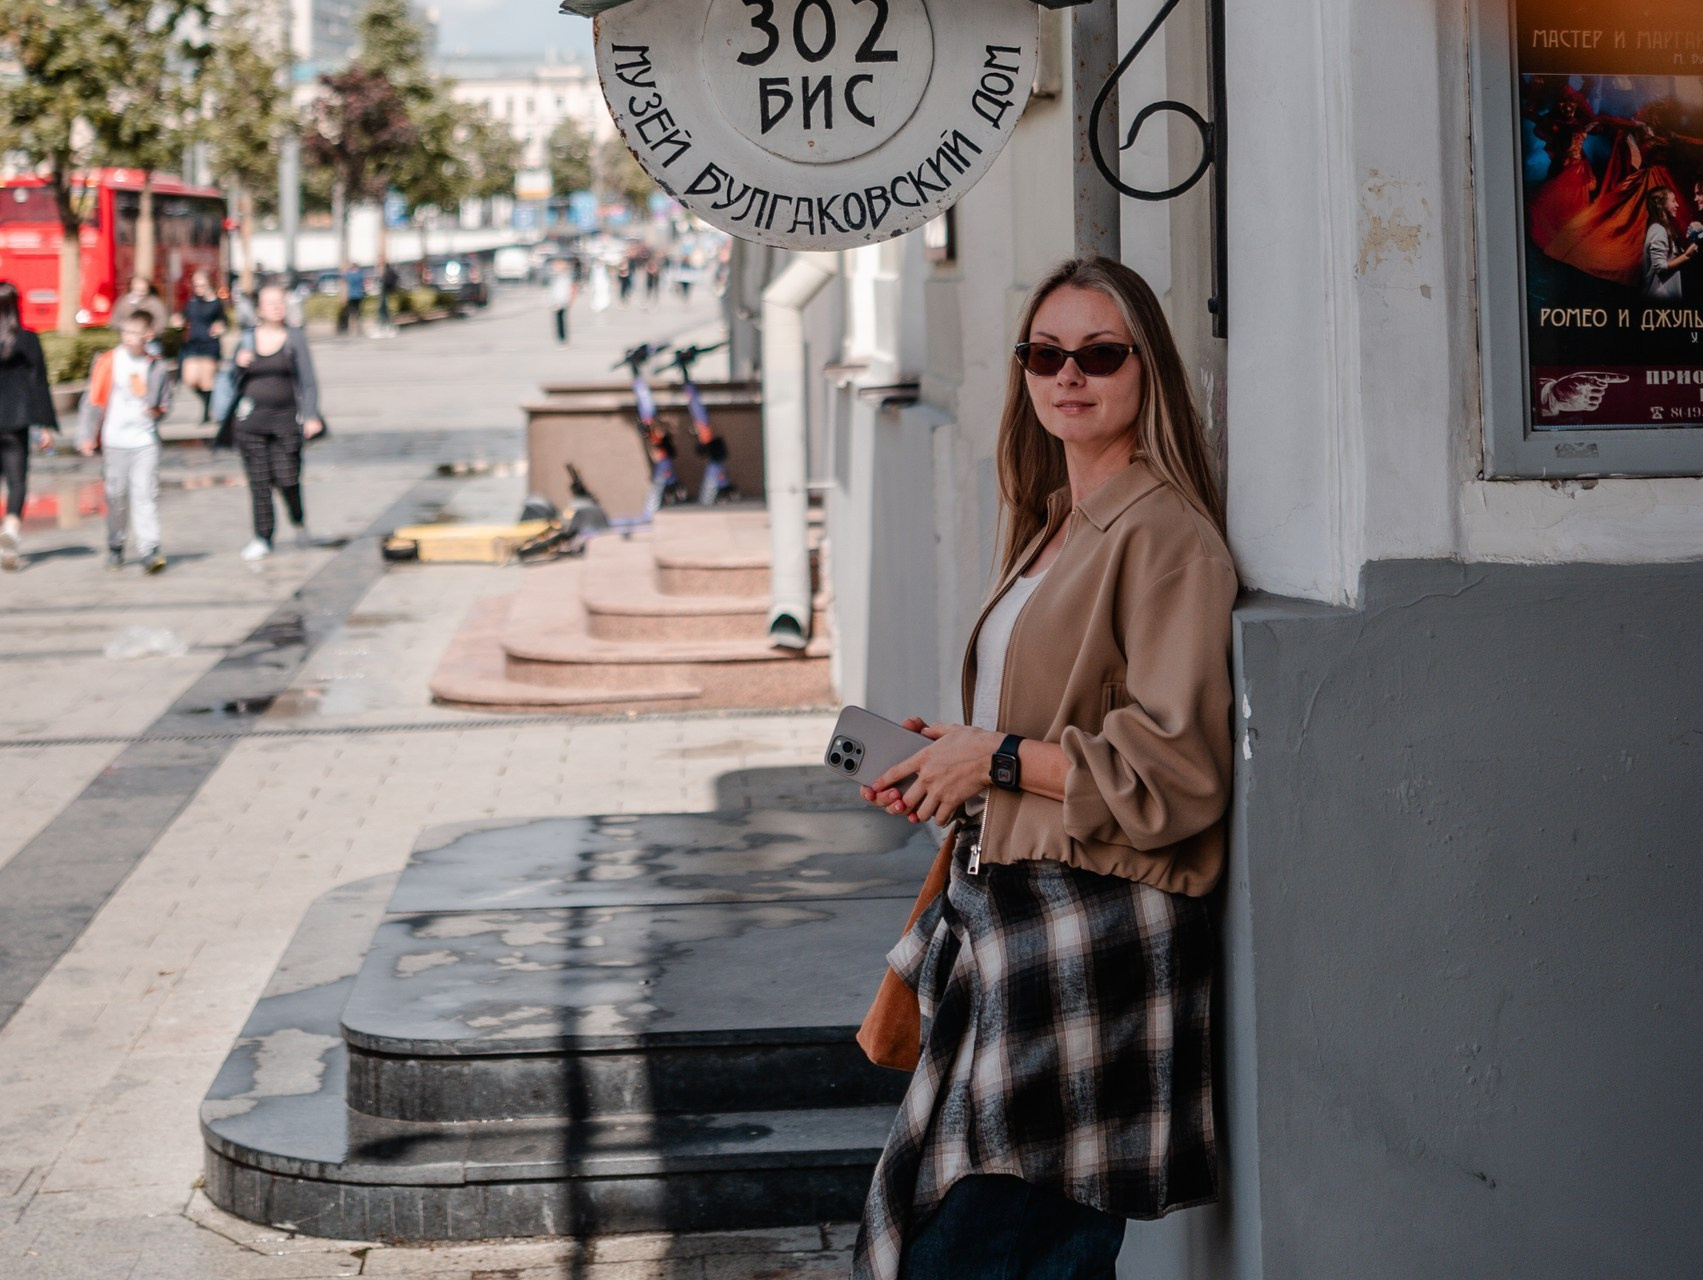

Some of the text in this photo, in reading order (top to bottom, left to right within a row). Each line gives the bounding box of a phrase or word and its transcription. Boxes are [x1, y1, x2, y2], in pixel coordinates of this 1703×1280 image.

[1532, 29, 1603, 49] МАСТЕР
[1614, 30, 1626, 49] И
[758, 73, 876, 136] БИС
[610, 42, 1022, 236] МУЗЕЙ БУЛГАКОВСКИЙ ДОМ
[1540, 308, 1608, 328] РОМЕО
[1618, 309, 1630, 328] И
